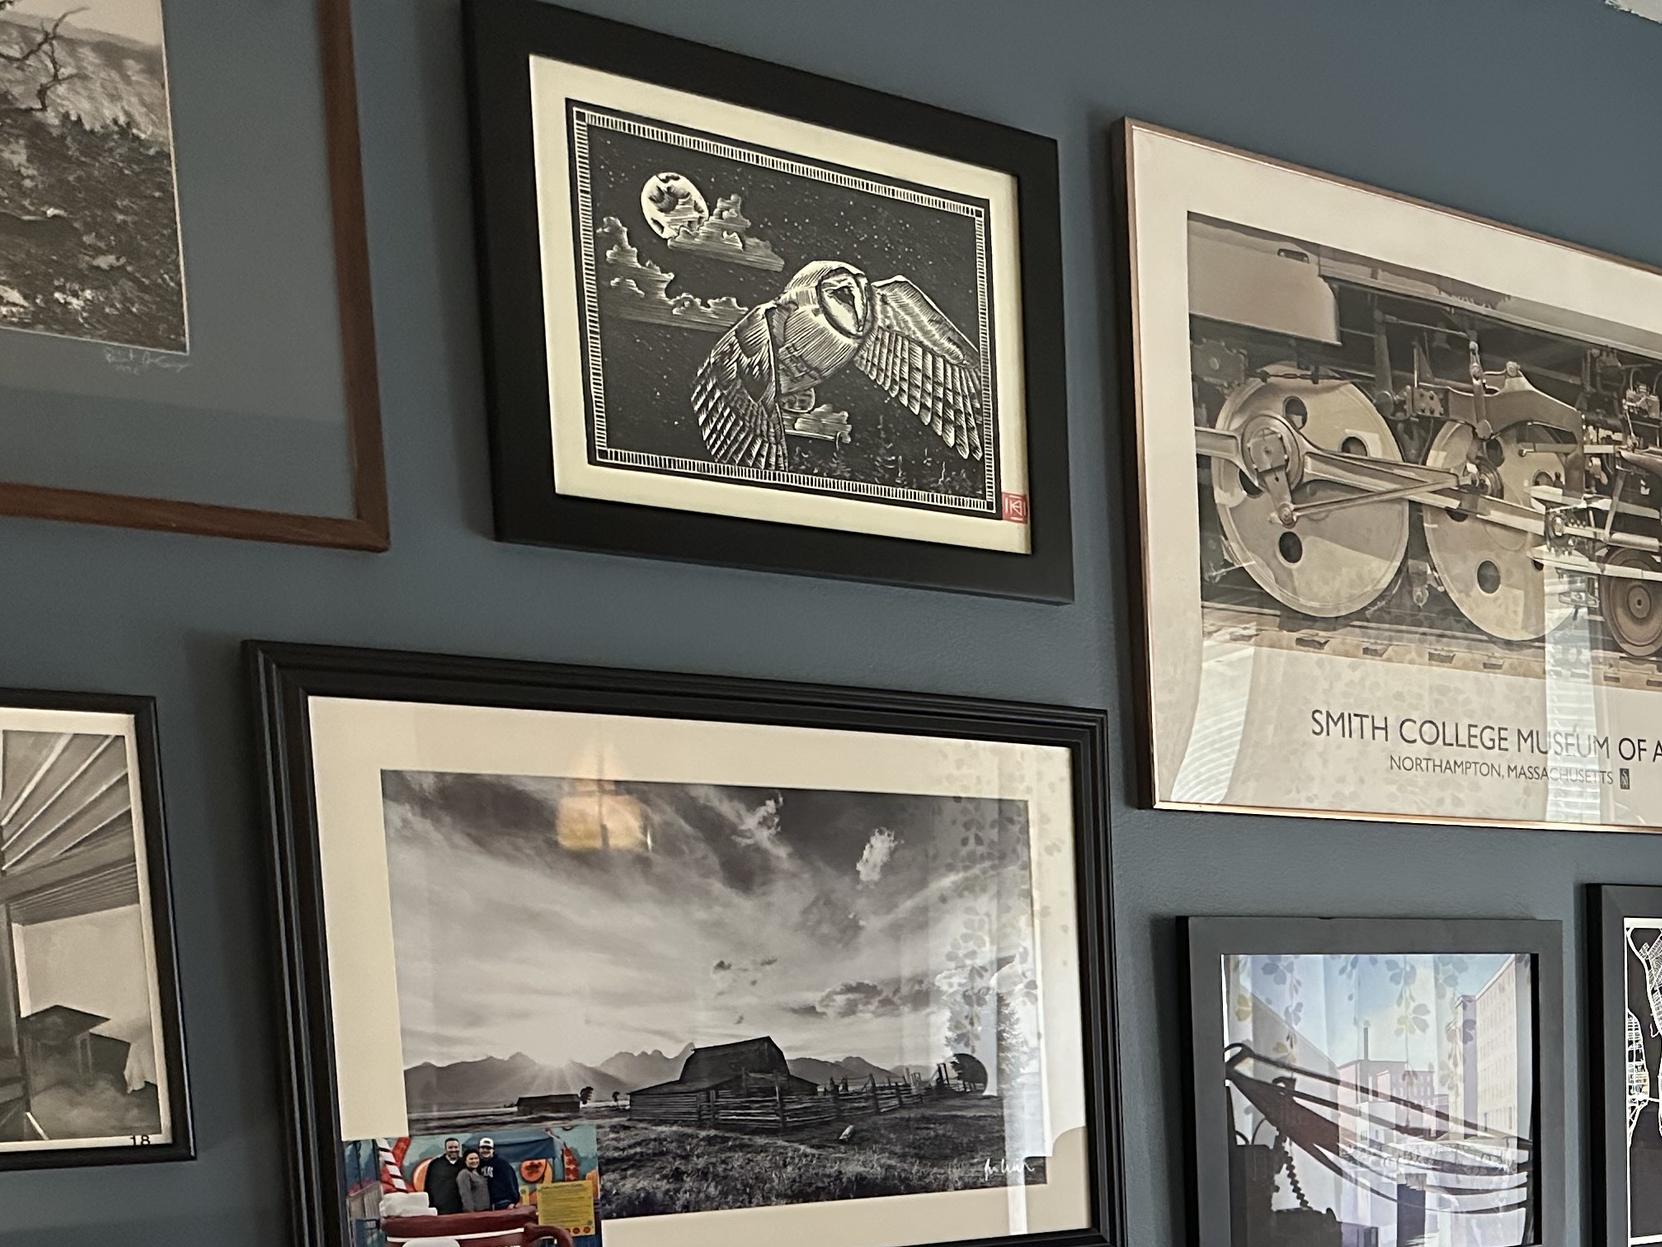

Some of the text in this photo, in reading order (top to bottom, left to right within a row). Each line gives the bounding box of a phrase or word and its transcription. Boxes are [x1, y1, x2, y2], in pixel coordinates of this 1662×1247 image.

[1311, 709, 1389, 742] SMITH
[1399, 718, 1509, 752] COLLEGE
[1517, 728, 1610, 759] MUSEUM
[1618, 737, 1648, 762] OF
[1389, 754, 1505, 779] NORTHAMPTON,
[1507, 764, 1615, 785] MASSACHUSETTS
[130, 1135, 150, 1146] 18
